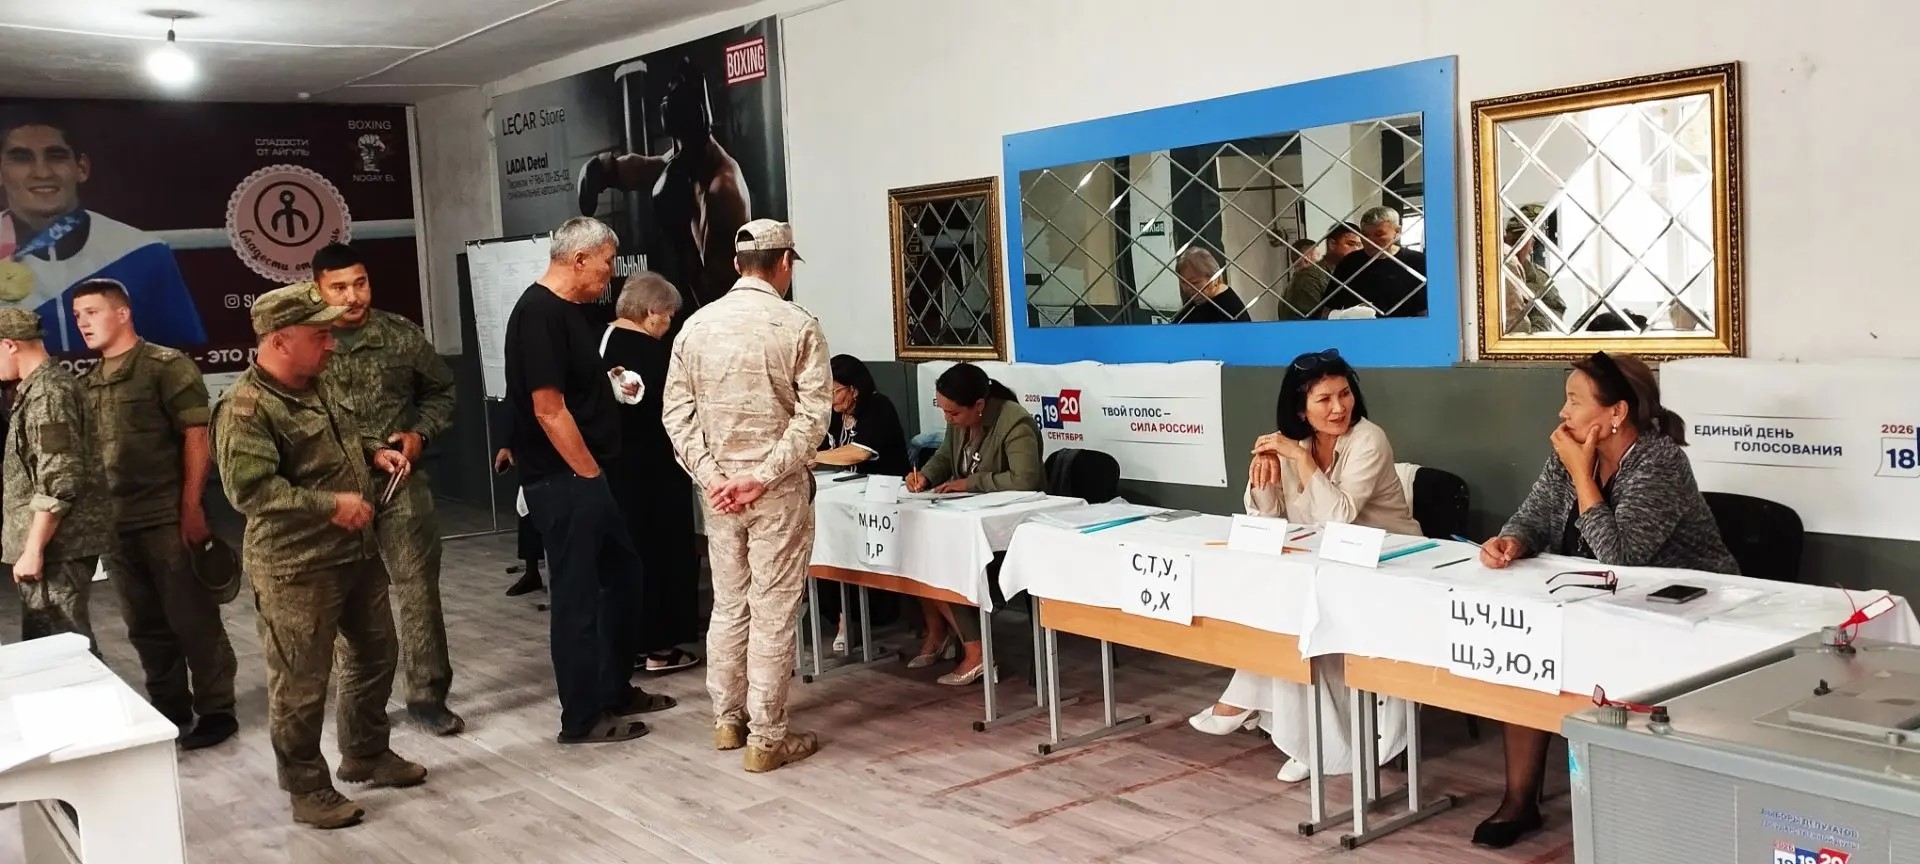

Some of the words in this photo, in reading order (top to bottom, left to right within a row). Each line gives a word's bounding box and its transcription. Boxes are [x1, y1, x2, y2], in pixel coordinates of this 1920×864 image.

[727, 44, 765, 78] BOXING
[348, 120, 392, 130] BOXING
[502, 112, 537, 136] LECAR
[540, 109, 565, 127] Store
[255, 138, 309, 147] СЛАДОСТИ
[256, 148, 269, 157] ОТ
[271, 147, 310, 157] АЙГУЛЬ
[506, 157, 527, 175] LADA
[527, 152, 548, 171] Detal
[353, 174, 382, 182] NOGAY
[385, 174, 395, 182] EL
[208, 349, 243, 364] ЭТО
[1025, 394, 1040, 402] 2026
[1044, 404, 1058, 423] 19
[1060, 397, 1079, 415] 20
[1102, 405, 1127, 417] ТВОЙ
[1129, 407, 1162, 418] ГОЛОС
[1130, 421, 1158, 433] СИЛА
[1159, 423, 1204, 435] РОССИИ!
[1694, 424, 1753, 437] ЕДИНЫЙ
[1756, 427, 1794, 439] ДЕНЬ
[1881, 424, 1914, 434] 2026
[1047, 431, 1084, 442] СЕНТЯБРЯ
[1734, 441, 1843, 456] ГОЛОСОВАНИЯ
[1885, 448, 1916, 469] 18
[1132, 553, 1178, 582] С,Т,У,
[1140, 588, 1171, 612] Ф,Х
[1451, 600, 1532, 635] Ц,Ч,Ш,
[1451, 643, 1555, 681] Щ,Э,Ю,Я
